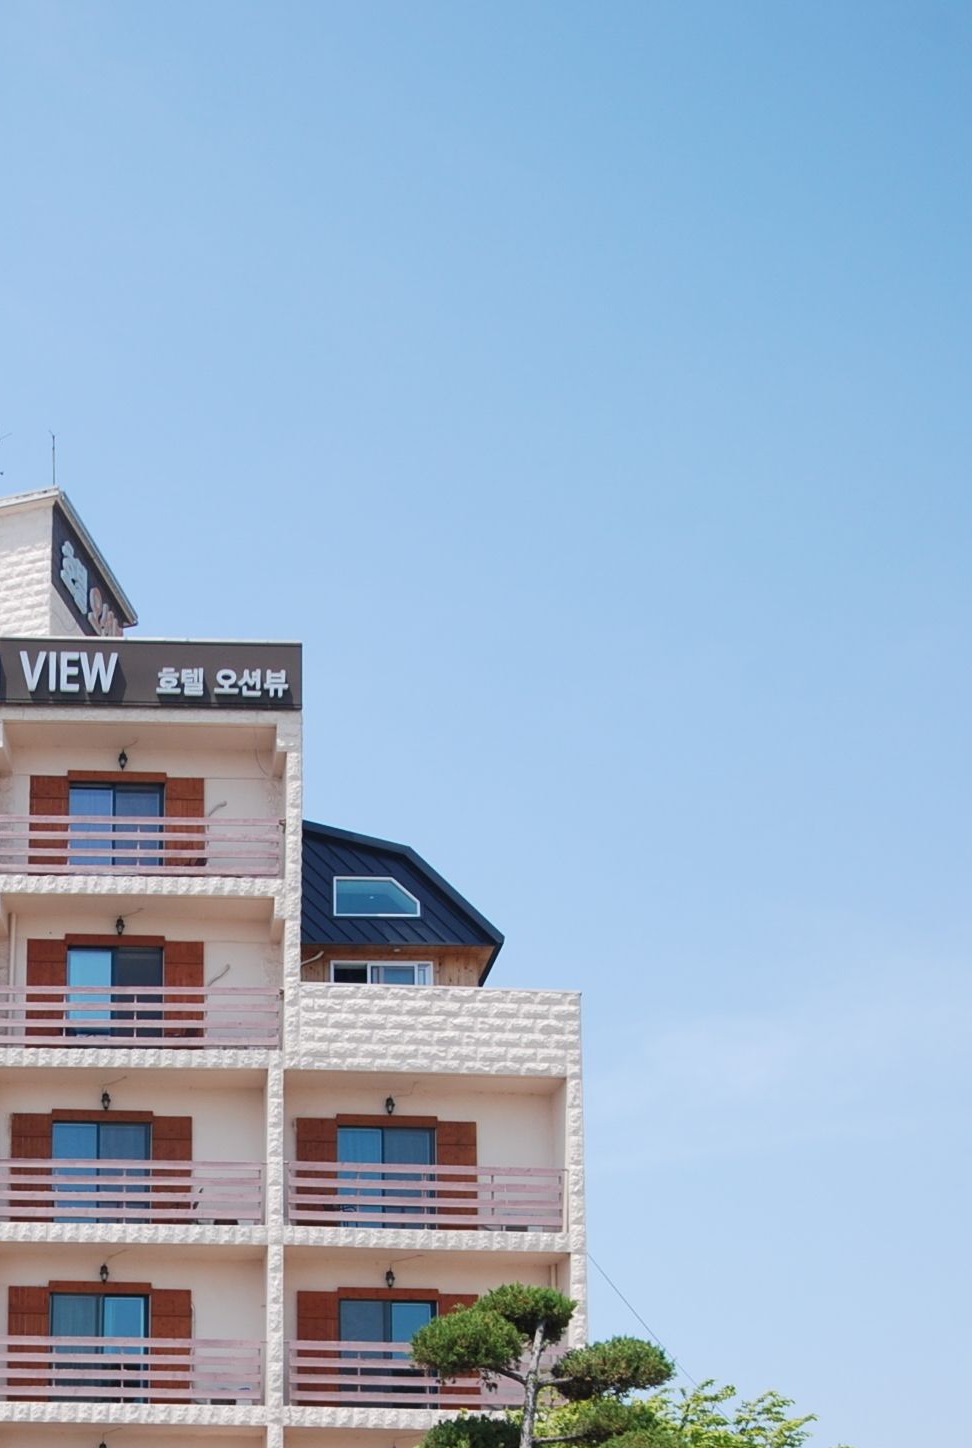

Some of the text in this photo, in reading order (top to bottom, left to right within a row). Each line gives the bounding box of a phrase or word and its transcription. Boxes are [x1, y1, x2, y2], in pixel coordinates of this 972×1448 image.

[19, 650, 119, 694] VIEW
[155, 666, 289, 698] 호텔 오션뷰
